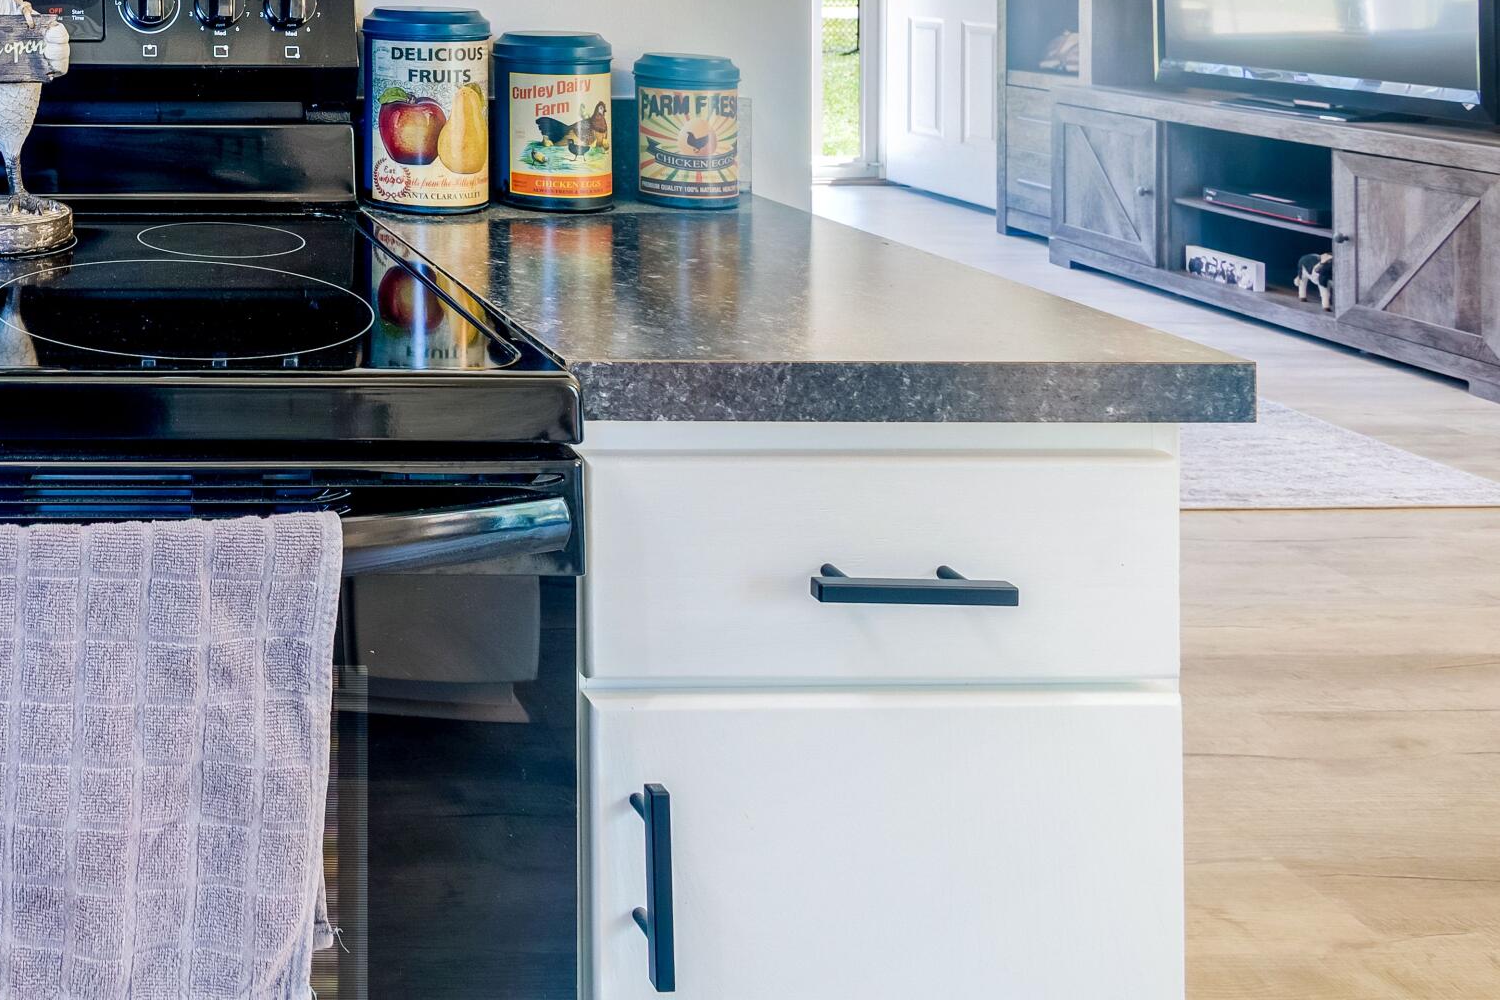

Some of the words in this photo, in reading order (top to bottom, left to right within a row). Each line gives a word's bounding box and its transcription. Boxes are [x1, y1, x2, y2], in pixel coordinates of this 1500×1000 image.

[4, 39, 46, 63] open
[391, 47, 483, 61] DELICIOUS
[408, 69, 471, 83] FRUITS
[513, 85, 554, 99] Curley
[557, 78, 591, 95] Dairy
[535, 101, 569, 117] Farm
[641, 89, 689, 121] FARM
[656, 153, 708, 168] CHICKEN
[711, 154, 734, 167] EGGS
[535, 180, 579, 188] CHICKEN
[582, 180, 601, 188] EGGS
[661, 184, 683, 192] QUALITY
